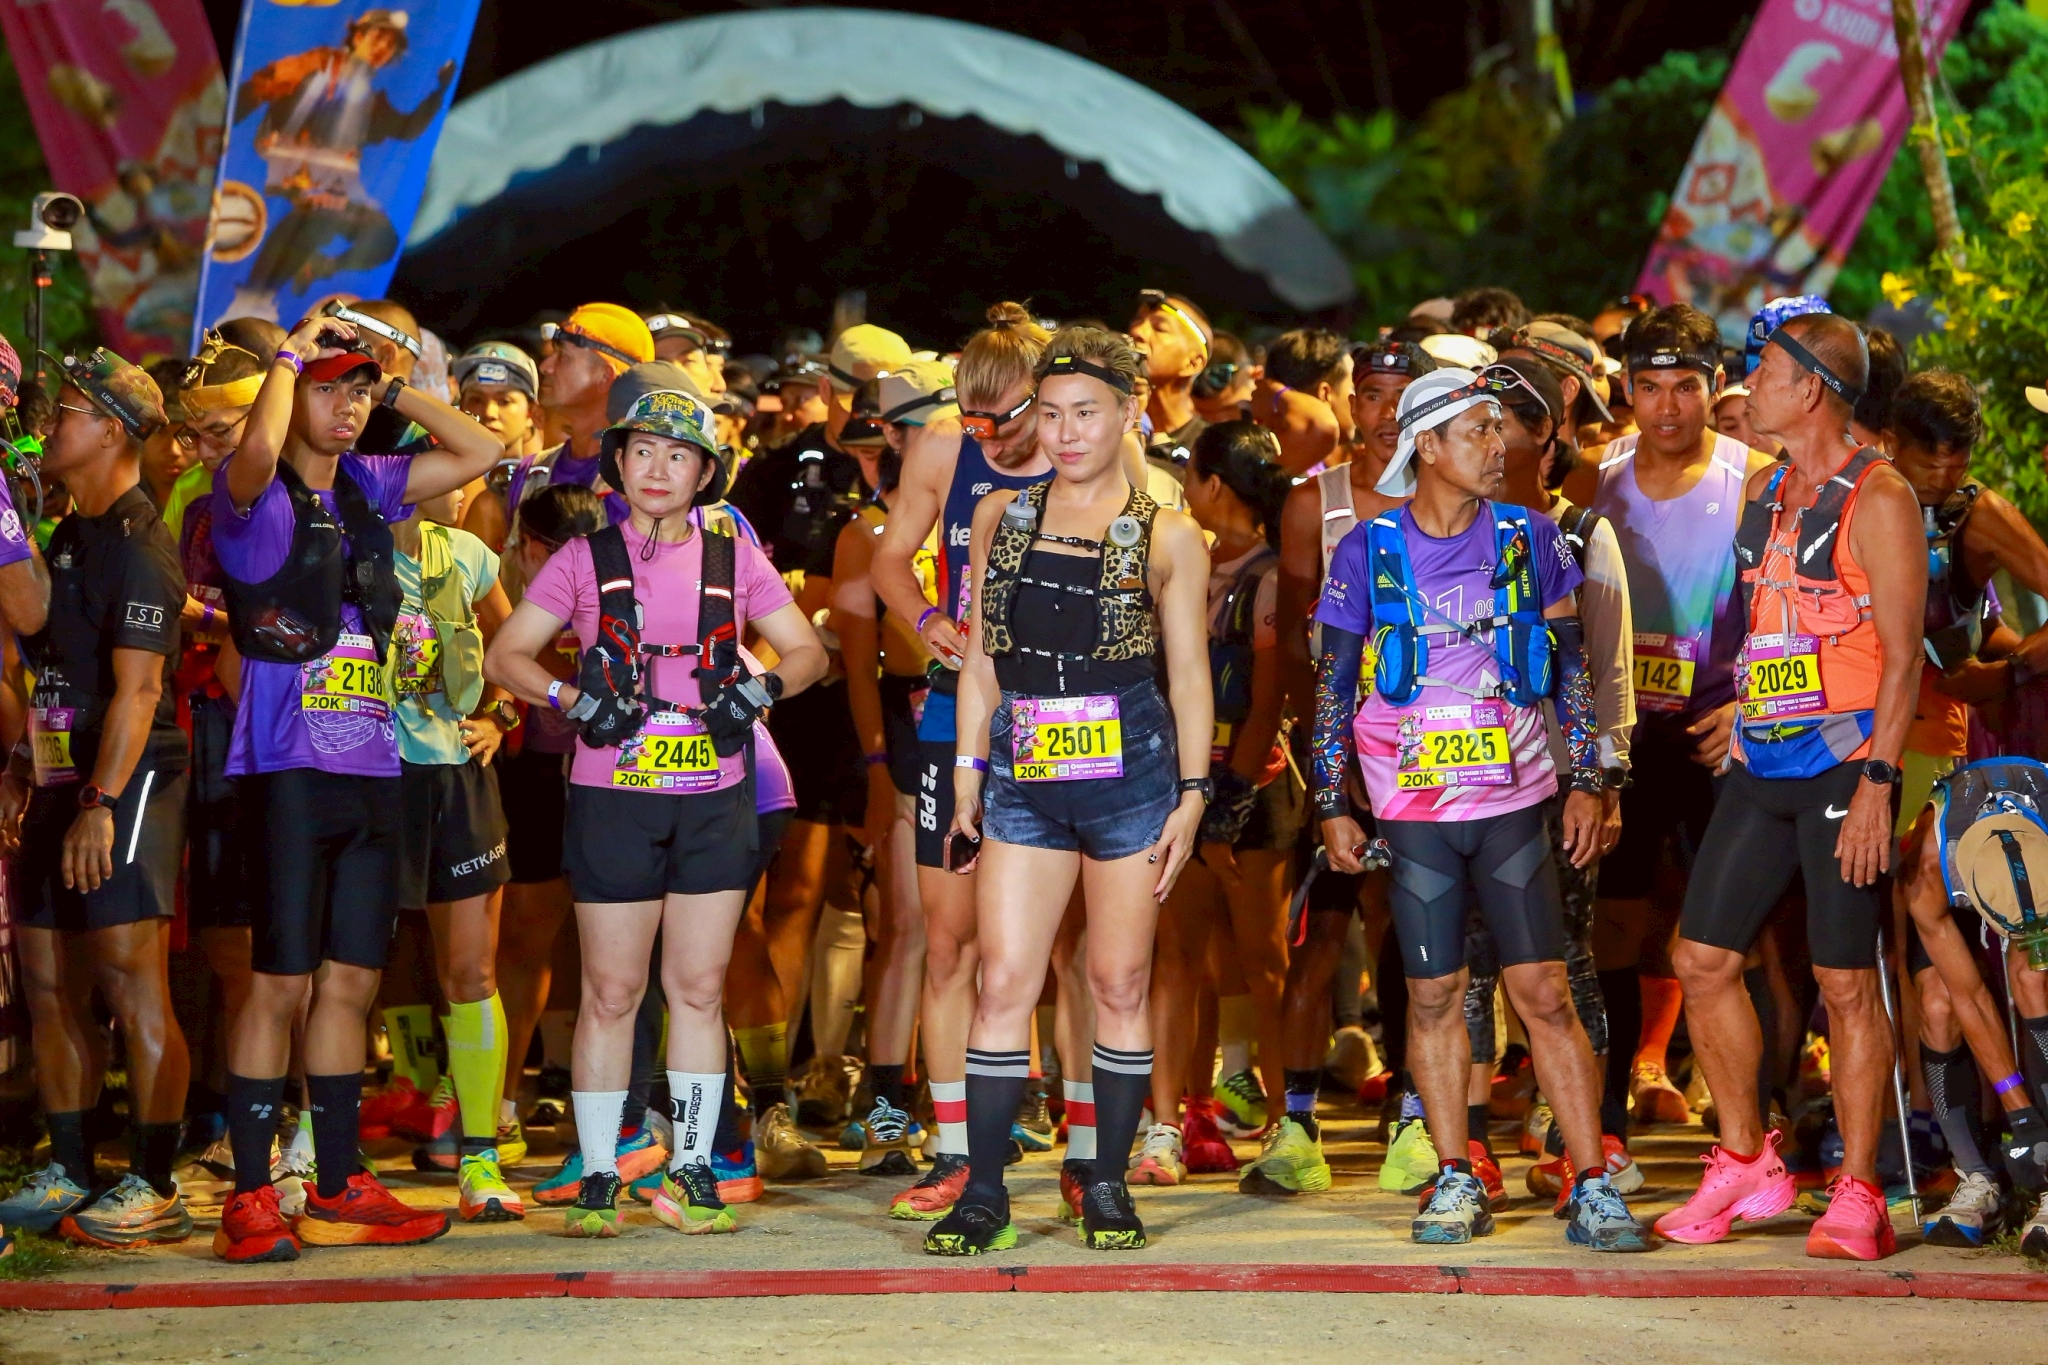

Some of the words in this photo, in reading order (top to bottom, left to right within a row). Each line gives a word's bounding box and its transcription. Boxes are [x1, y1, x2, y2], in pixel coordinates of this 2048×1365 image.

[101, 392, 114, 404] LED
[112, 403, 139, 427] HEADLIGHT
[1402, 416, 1412, 428] LED
[1412, 398, 1447, 420] HEADLIGHT
[1040, 580, 1060, 589] kinetik
[1520, 567, 1531, 598] NIJIE
[342, 661, 383, 697] 2138
[1756, 659, 1808, 695] 2029
[305, 696, 341, 710] 20K
[654, 740, 710, 768] 2445
[1047, 725, 1106, 757] 2501
[1434, 732, 1496, 765] 2325
[617, 773, 651, 788] 20K
[1018, 765, 1047, 779] 20K
[1401, 773, 1434, 788] 20K
[920, 790, 936, 832] PB
[687, 1082, 702, 1132] TAPEDESIGN
